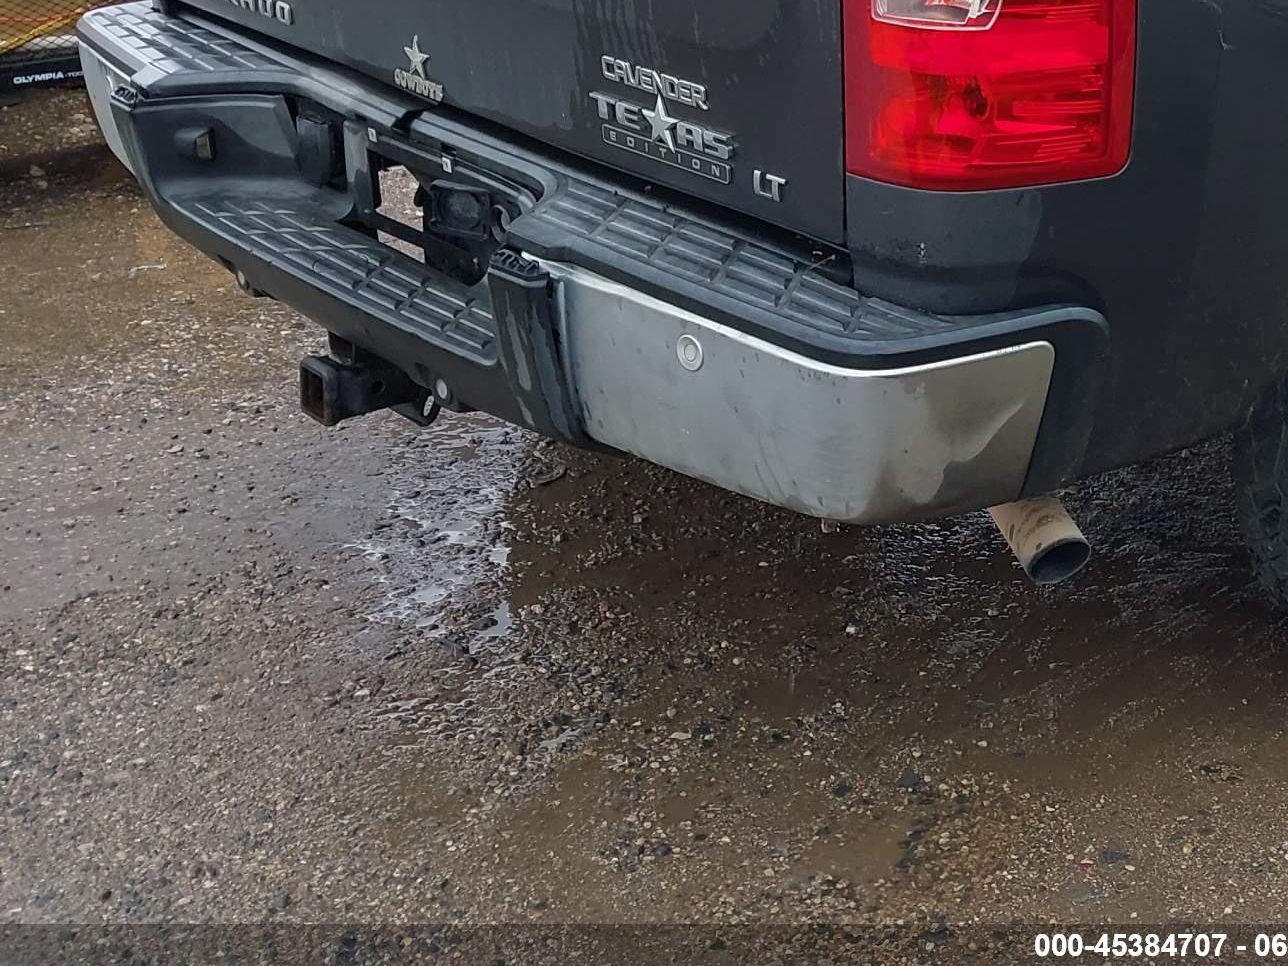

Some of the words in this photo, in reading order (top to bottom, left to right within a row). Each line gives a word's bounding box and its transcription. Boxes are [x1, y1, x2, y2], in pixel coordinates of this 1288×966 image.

[13, 71, 65, 85] OLYMPIA
[601, 54, 710, 111] CAVENDER
[609, 130, 721, 177] EDITION
[753, 169, 787, 203] LT
